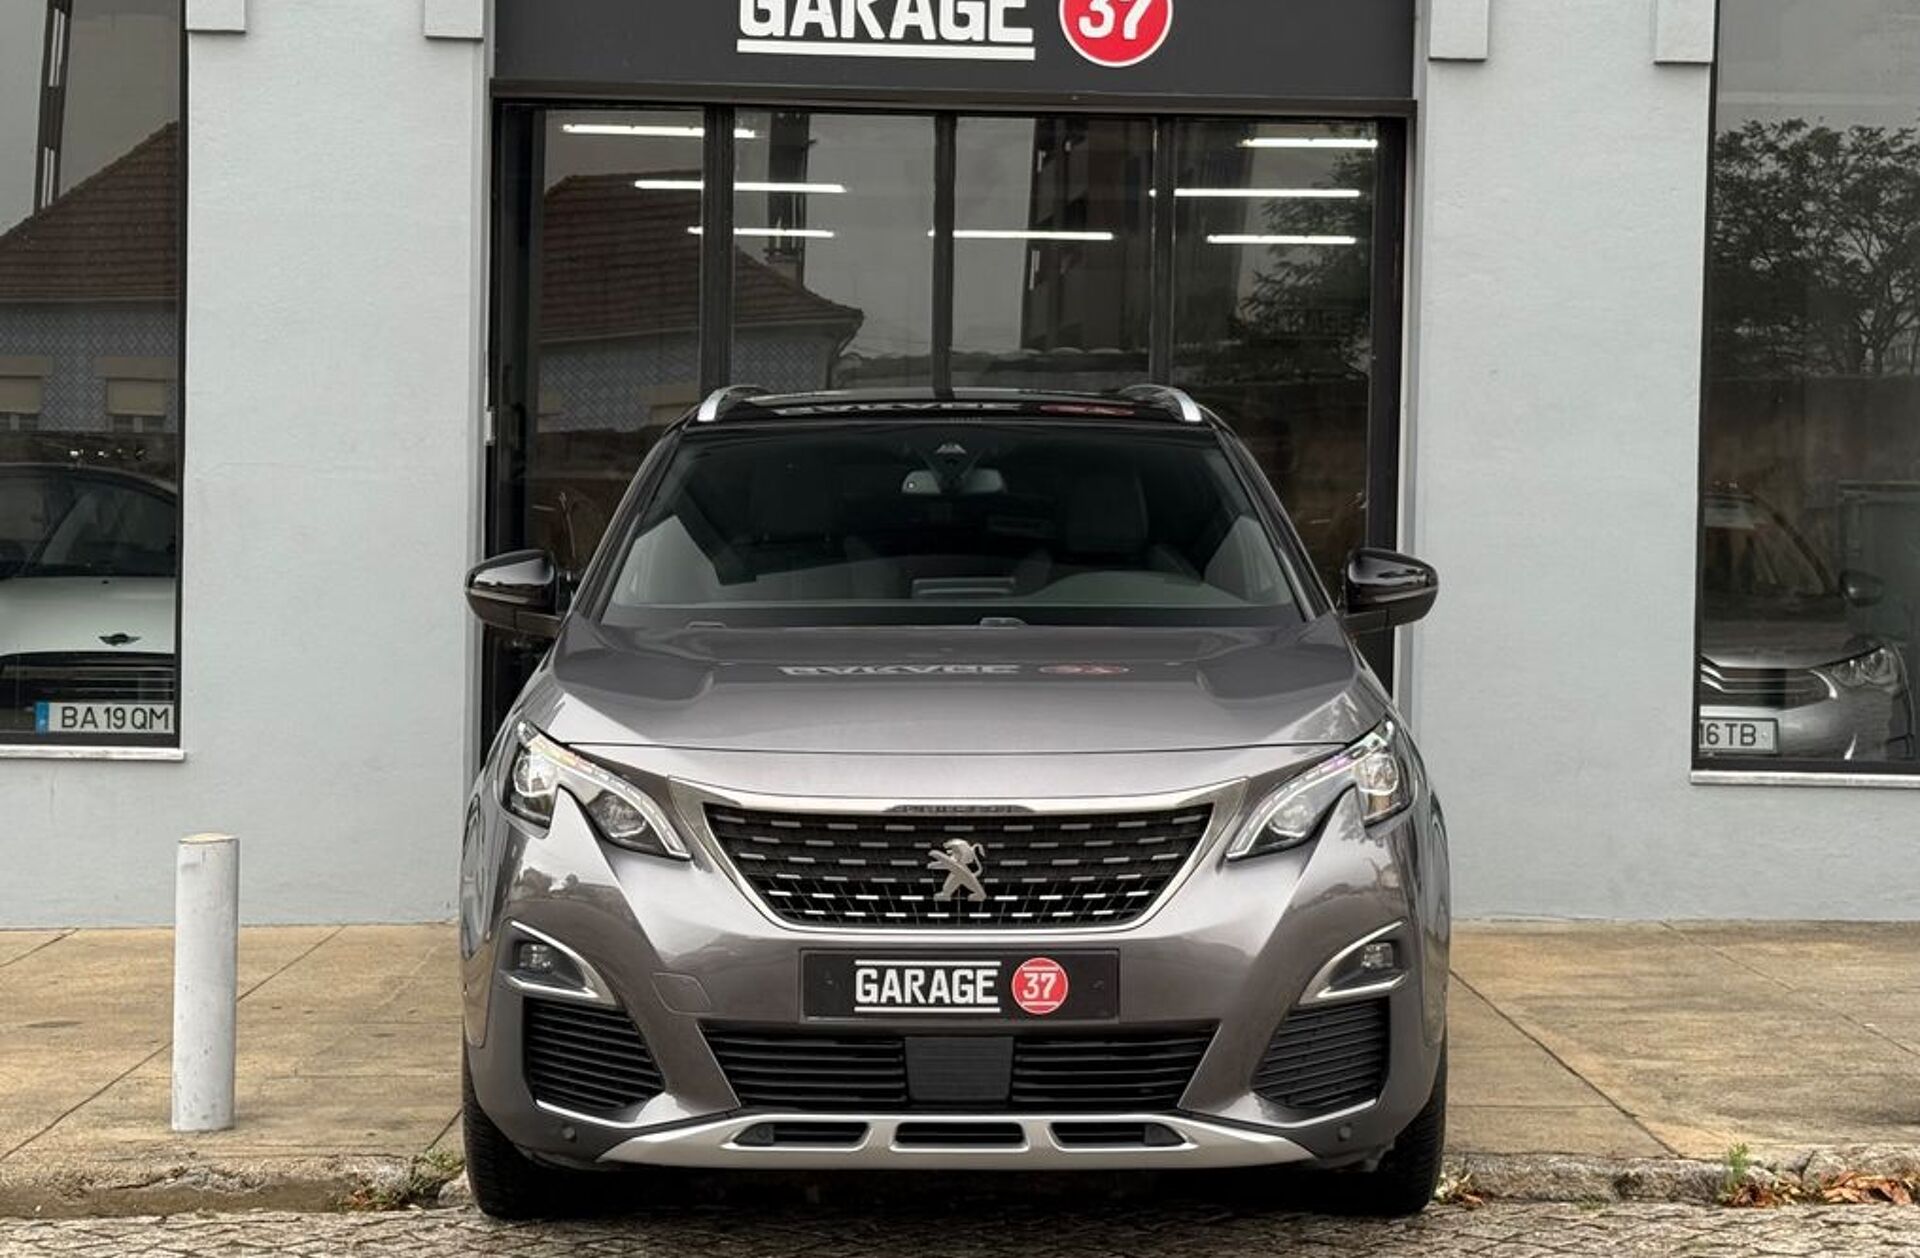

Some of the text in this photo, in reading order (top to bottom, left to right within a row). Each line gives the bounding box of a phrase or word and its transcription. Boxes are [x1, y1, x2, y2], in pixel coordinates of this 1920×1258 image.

[1078, 0, 1152, 40] 37
[61, 706, 169, 730] BA 19 QM
[1724, 723, 1757, 746] TB
[855, 968, 1058, 1005] GARAGE 37
